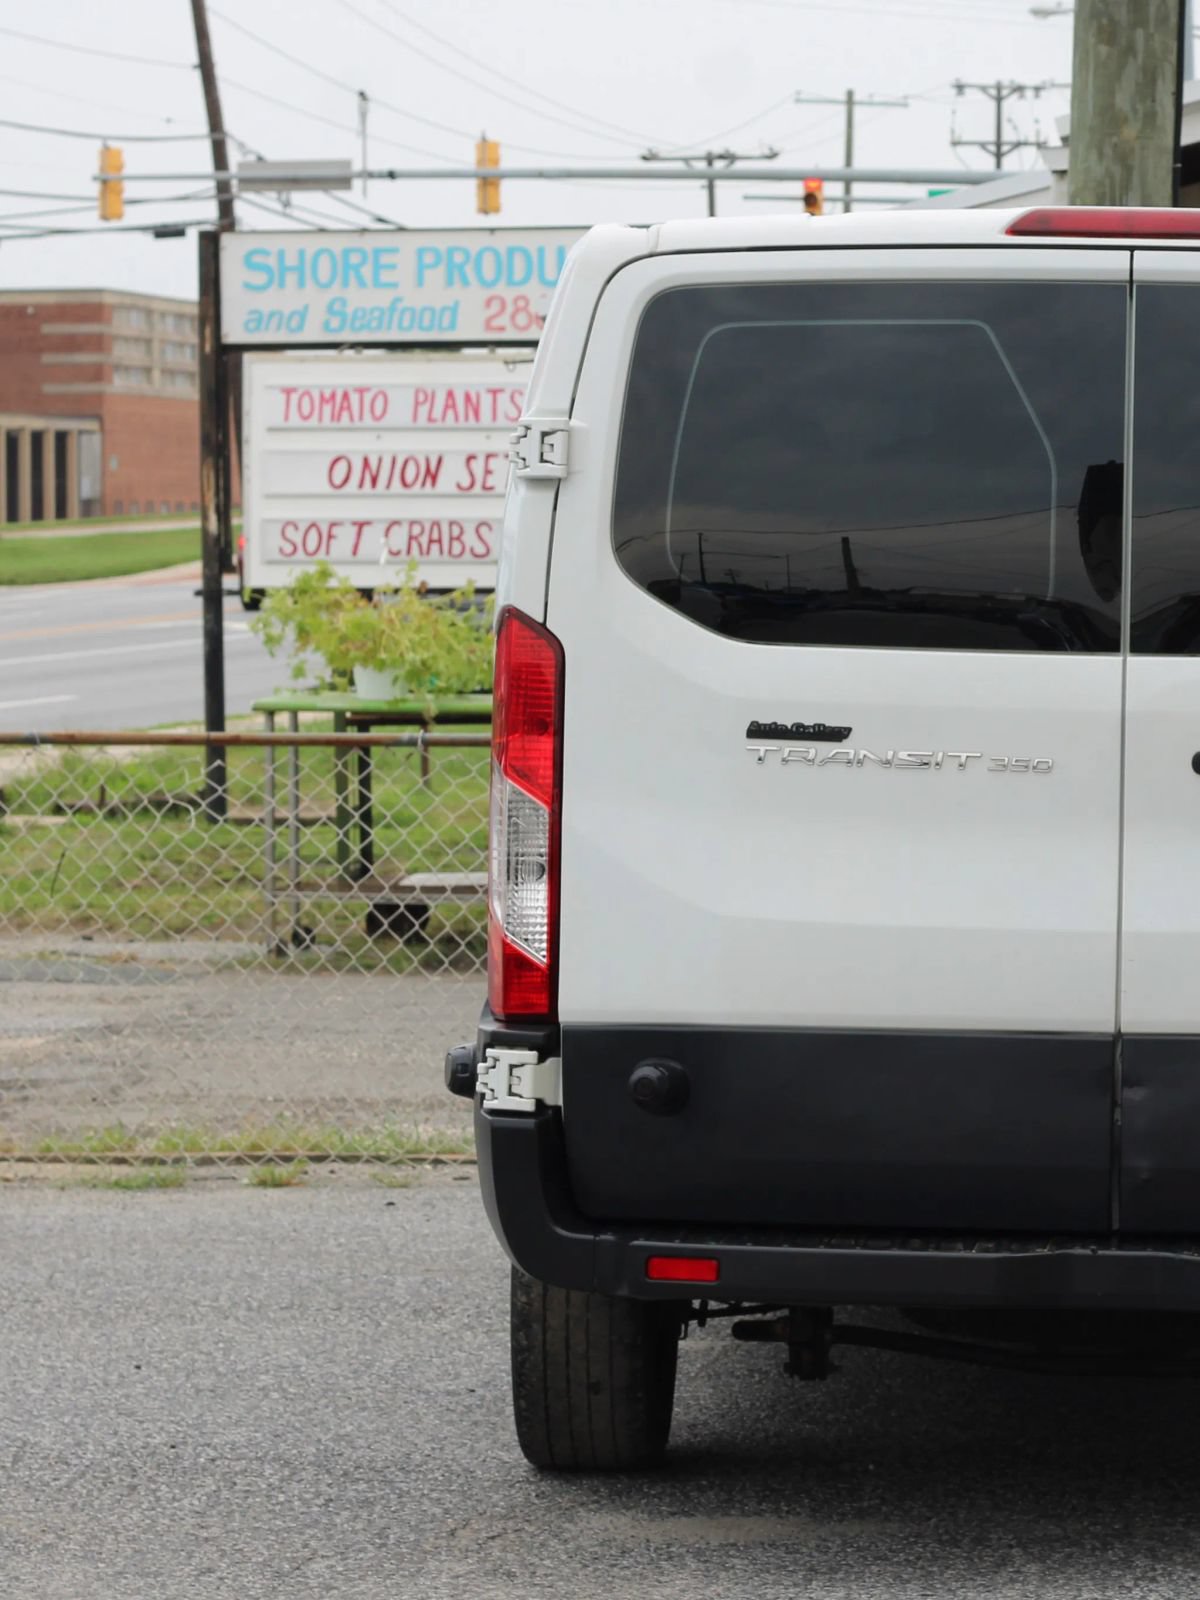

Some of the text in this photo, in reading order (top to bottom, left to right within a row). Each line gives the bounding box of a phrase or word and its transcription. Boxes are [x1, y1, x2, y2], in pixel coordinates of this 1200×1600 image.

[242, 247, 400, 291] SHORE
[243, 294, 546, 334] and Seafood 28
[280, 387, 525, 423] TOMATO PLANTS
[328, 452, 509, 492] ONION SE
[279, 521, 493, 559] SOFT CRABS
[746, 745, 1055, 774] TRANSIT 350
